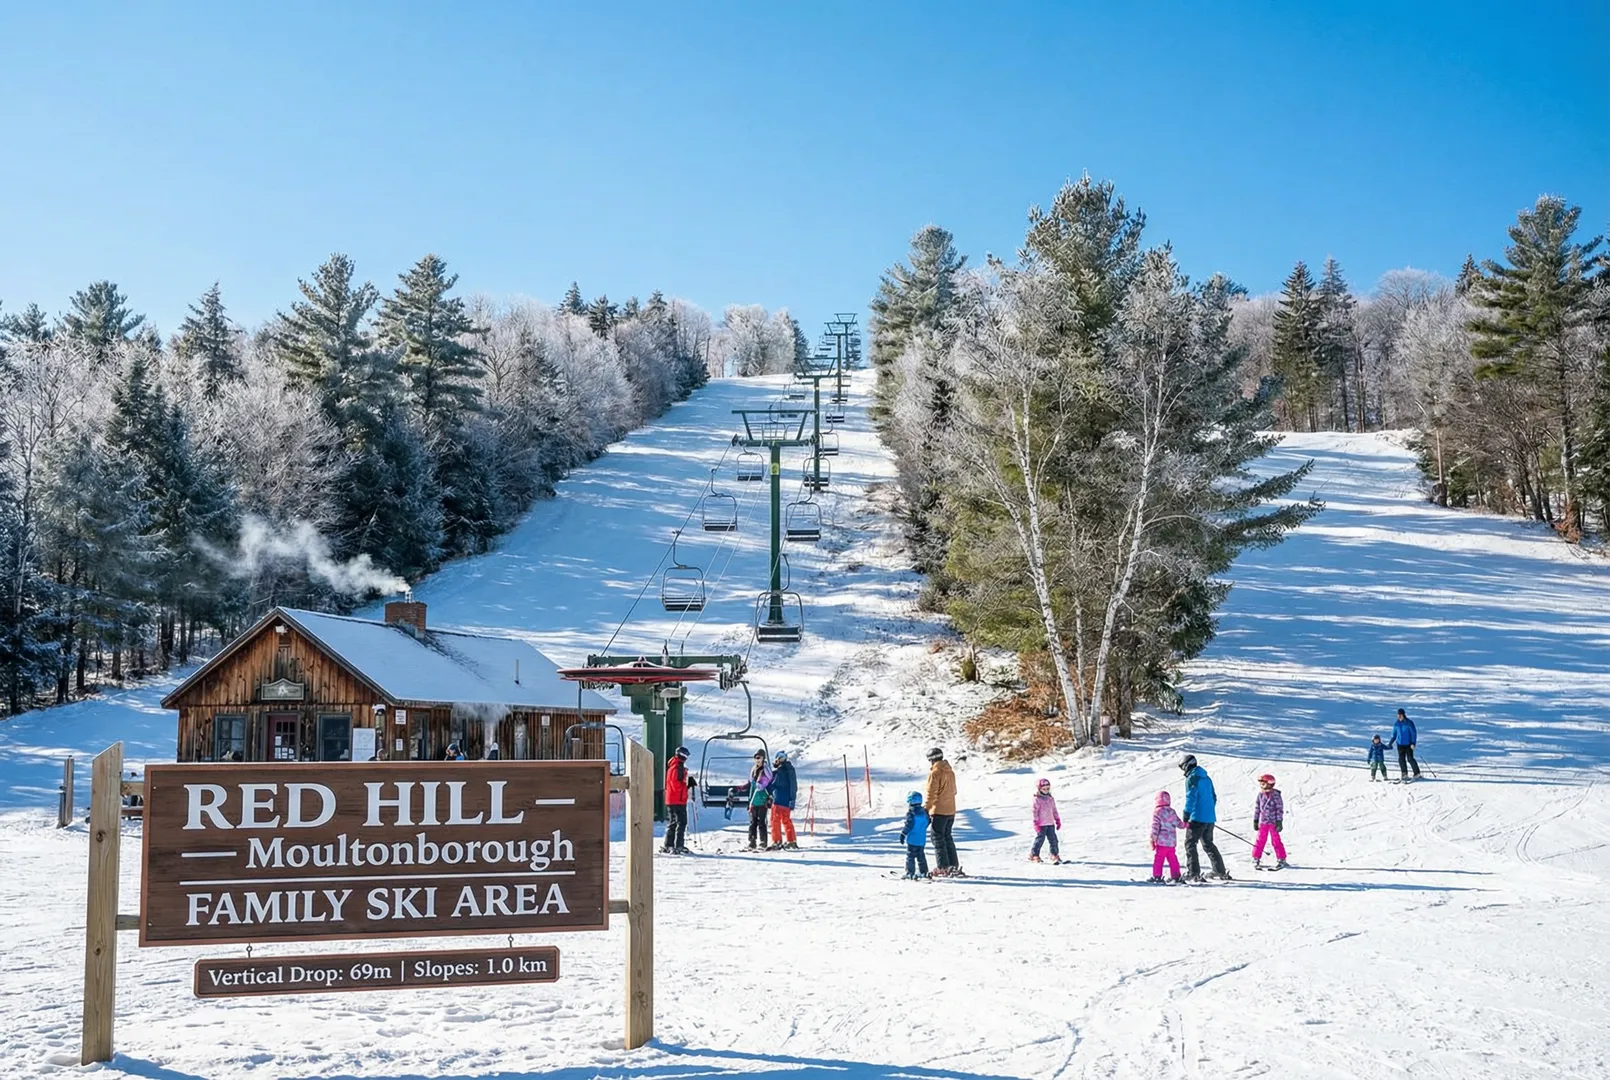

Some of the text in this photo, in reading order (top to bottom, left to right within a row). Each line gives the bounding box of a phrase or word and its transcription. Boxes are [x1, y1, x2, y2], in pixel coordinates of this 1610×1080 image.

[182, 780, 525, 830] RED HILL
[245, 829, 576, 872] Moultonborough
[185, 882, 570, 926] FAMILY SKI AREA
[208, 966, 284, 987] Vertical
[289, 966, 344, 987] Drop:
[349, 963, 392, 980] 69m
[413, 960, 479, 982] Slopes:
[487, 957, 514, 974] 1.0
[518, 956, 548, 973] km
